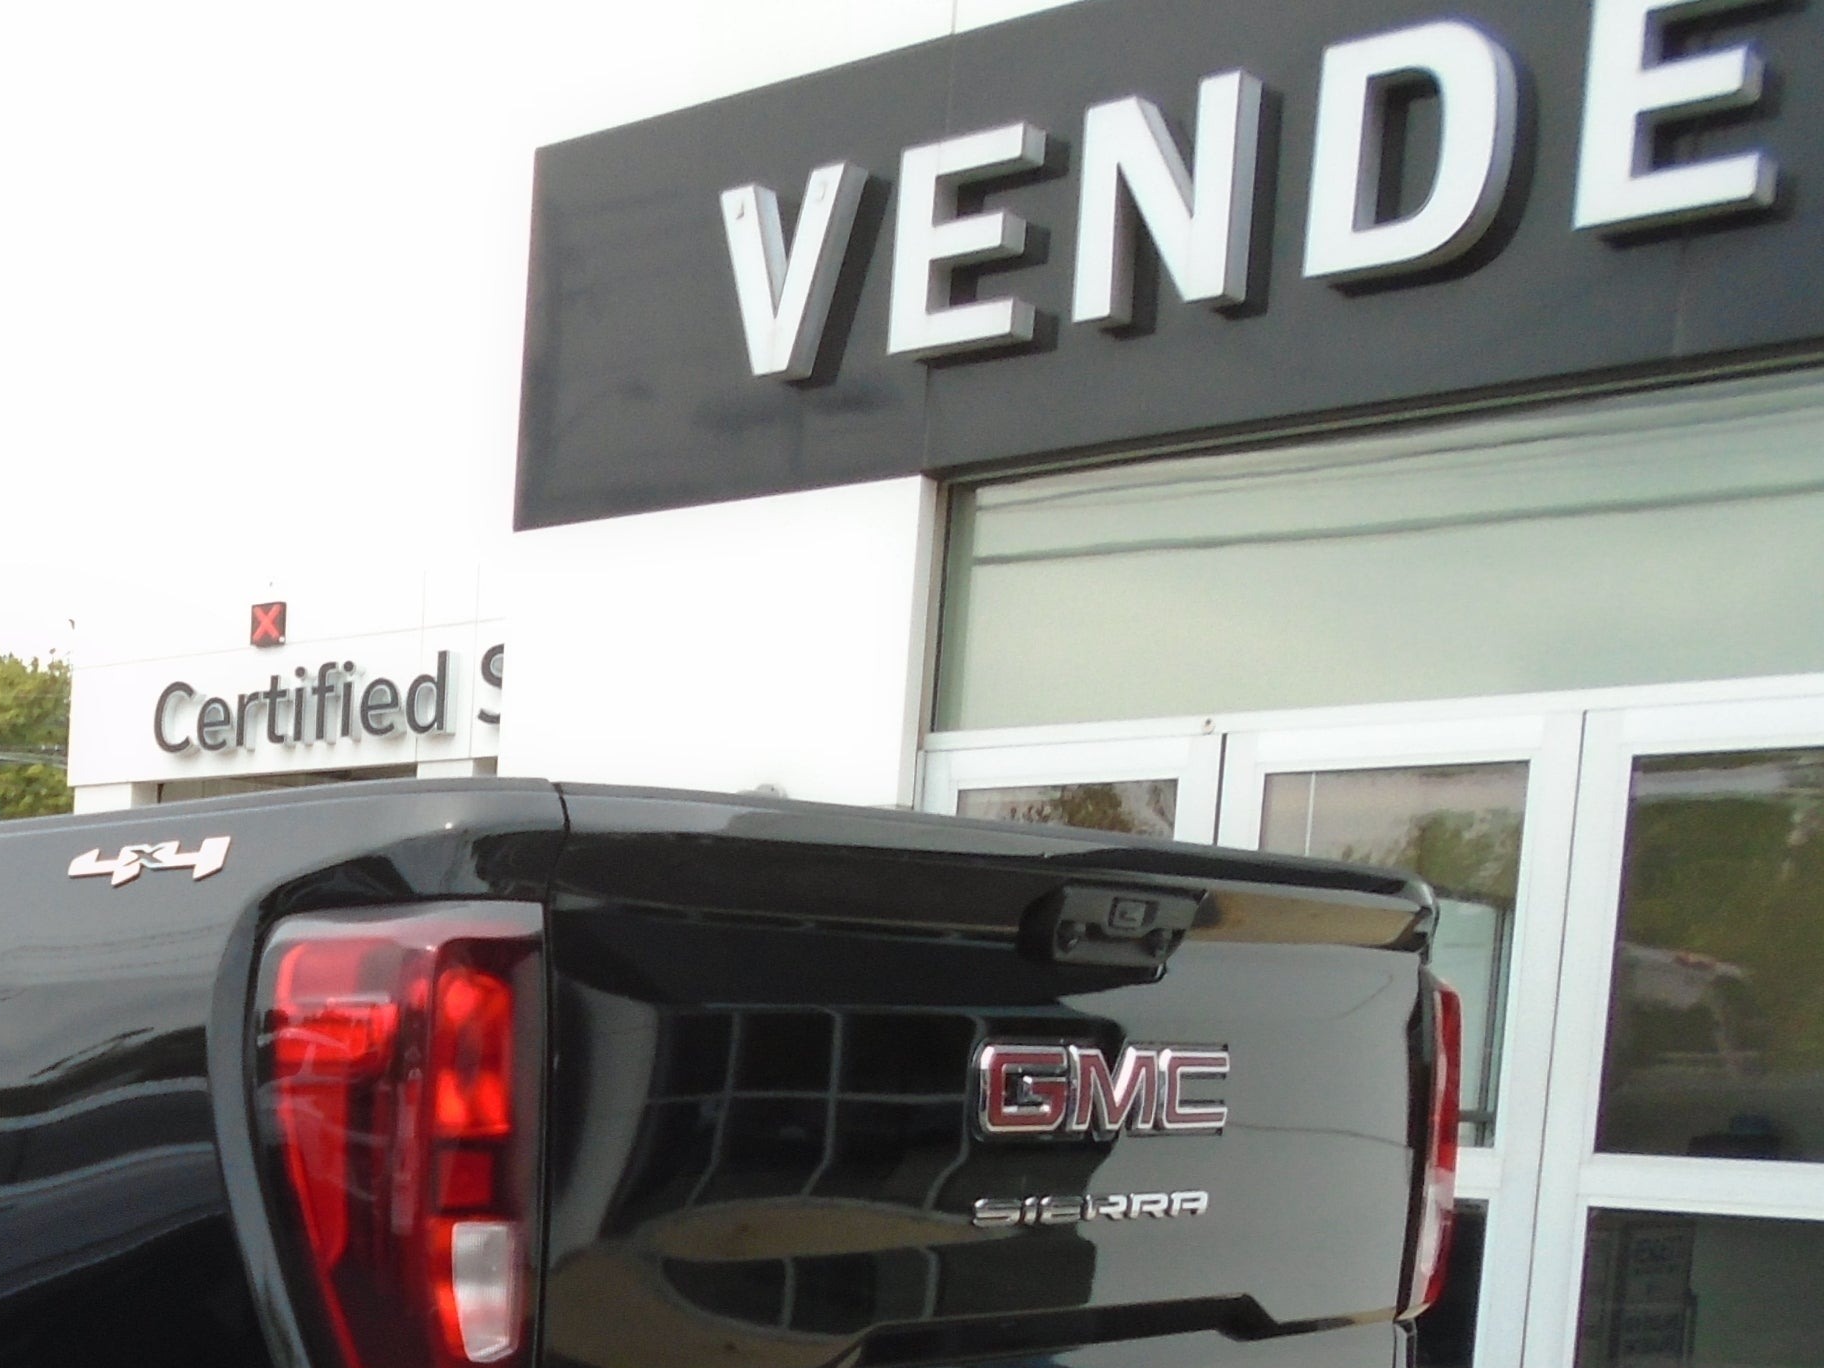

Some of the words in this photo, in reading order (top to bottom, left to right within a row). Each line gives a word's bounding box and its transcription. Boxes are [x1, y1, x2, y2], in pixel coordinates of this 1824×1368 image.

[720, 0, 1776, 380] VENDE
[153, 650, 454, 755] Certified
[978, 1043, 1231, 1134] GMC
[973, 1191, 1210, 1227] SIERRA
